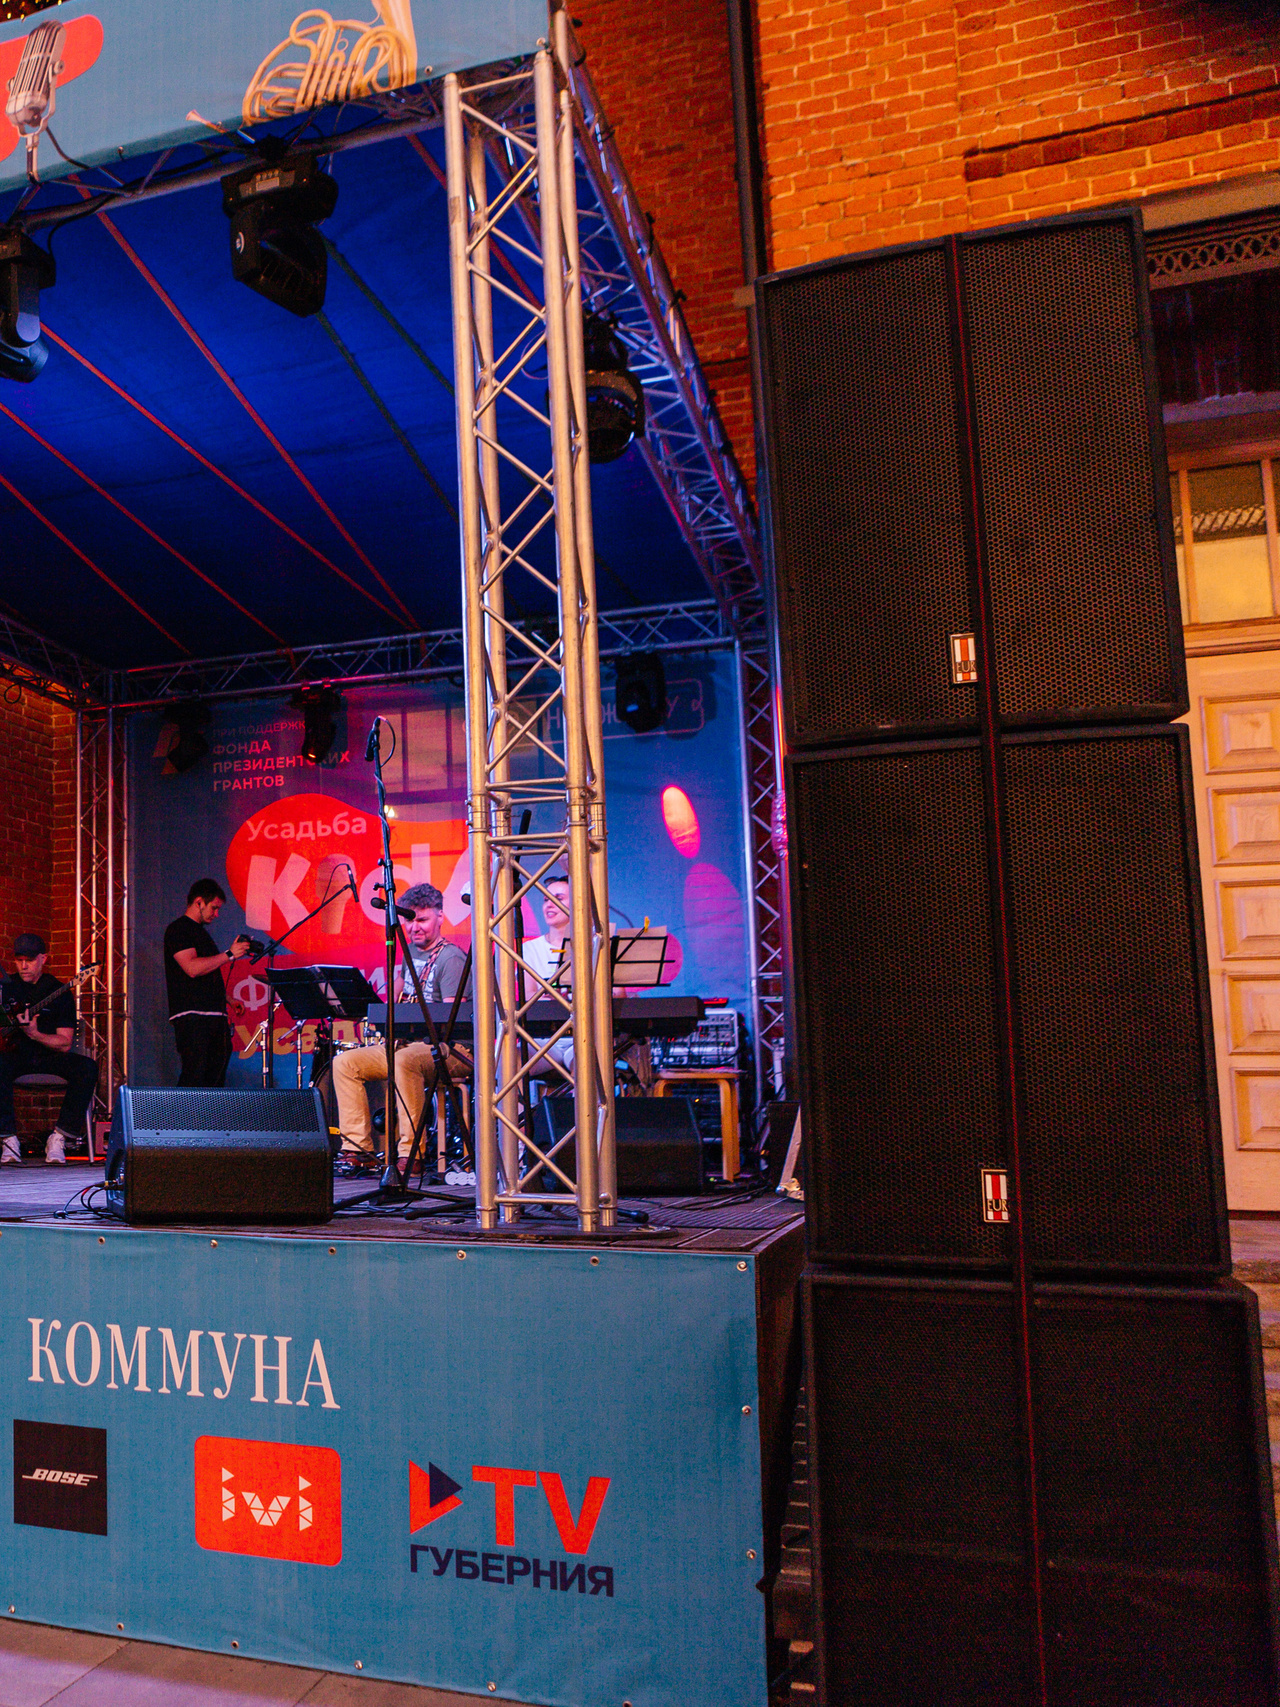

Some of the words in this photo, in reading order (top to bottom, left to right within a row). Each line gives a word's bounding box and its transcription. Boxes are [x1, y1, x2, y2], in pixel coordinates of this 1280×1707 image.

[237, 720, 308, 736] ПОДДЕРЖК
[213, 739, 272, 755] ФОНДА
[213, 775, 285, 792] ГРАНТОВ
[246, 811, 367, 841] Усадьба
[27, 1317, 341, 1409] КОММУНА
[22, 1468, 98, 1486] BOSE
[471, 1464, 612, 1555] TV
[409, 1544, 615, 1598] ГУБЕРНИЯ
